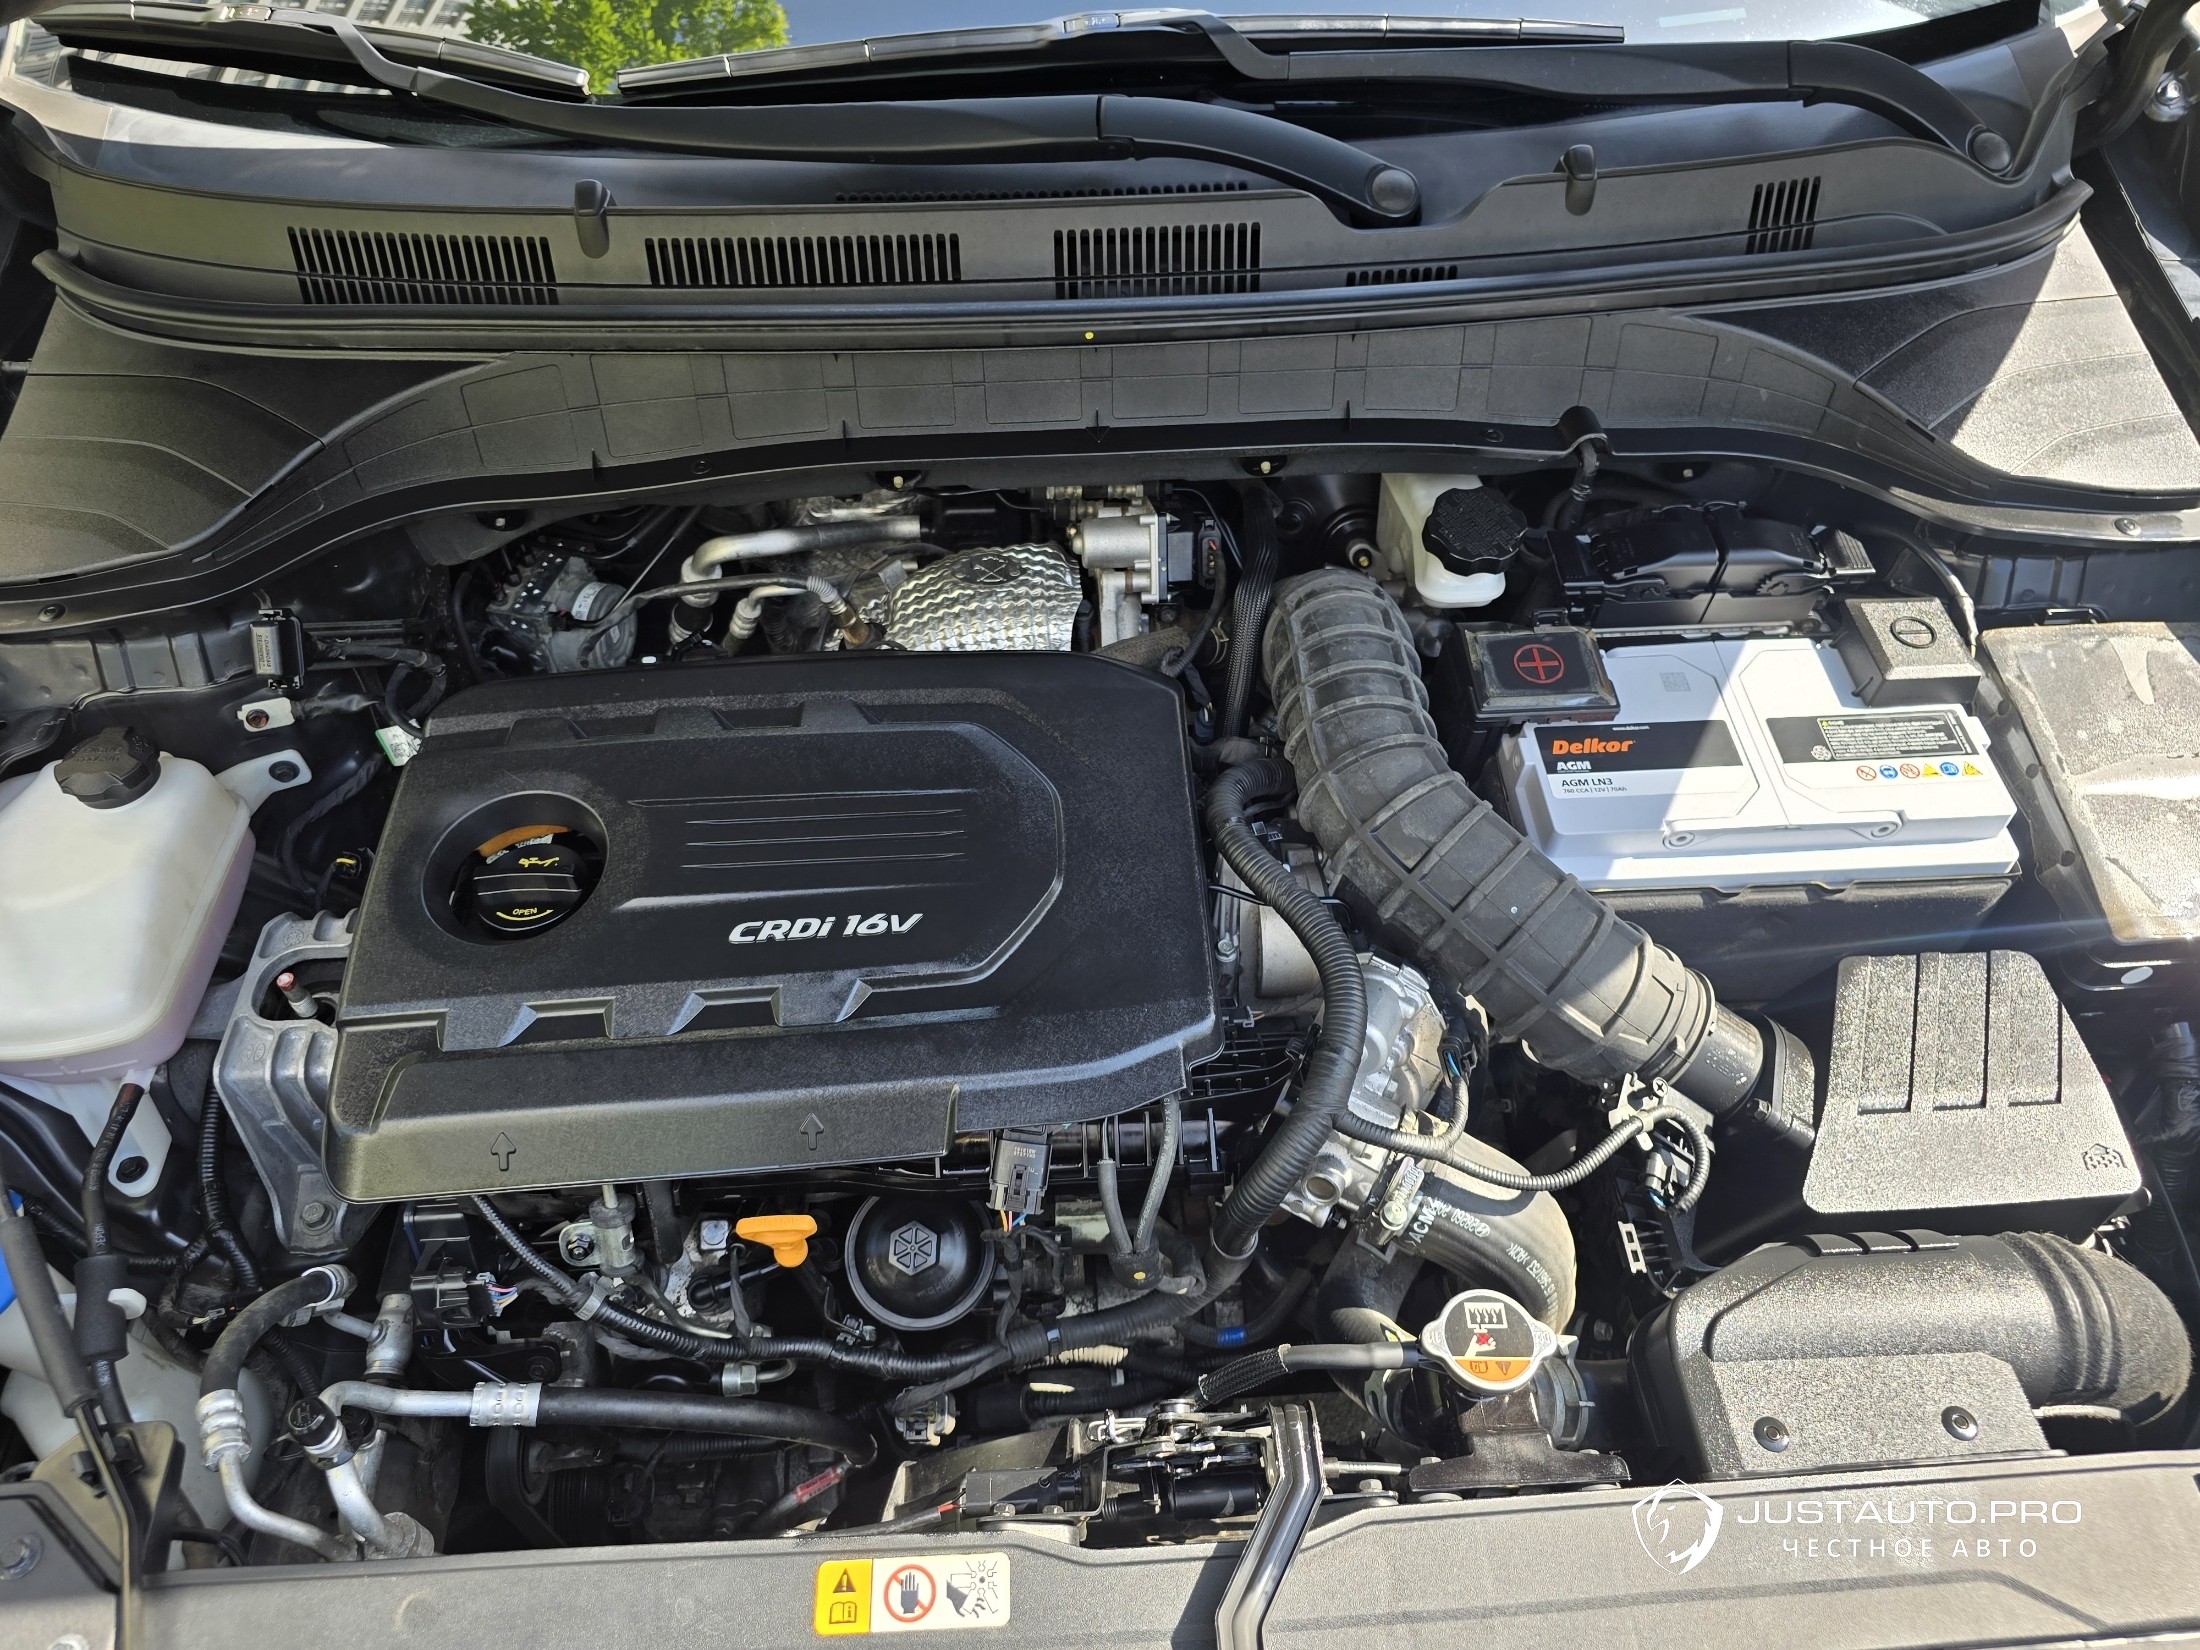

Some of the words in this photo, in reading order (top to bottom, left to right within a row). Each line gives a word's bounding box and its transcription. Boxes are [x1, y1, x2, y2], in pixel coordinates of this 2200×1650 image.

[1552, 738, 1633, 755] Delkor
[1556, 761, 1592, 771] AGM
[1561, 779, 1590, 787] AGM
[1591, 777, 1613, 786] LN3
[512, 908, 538, 916] OPEN
[728, 916, 837, 945] CRDi
[843, 913, 924, 938] 16V
[1163, 1097, 1170, 1106] 13
